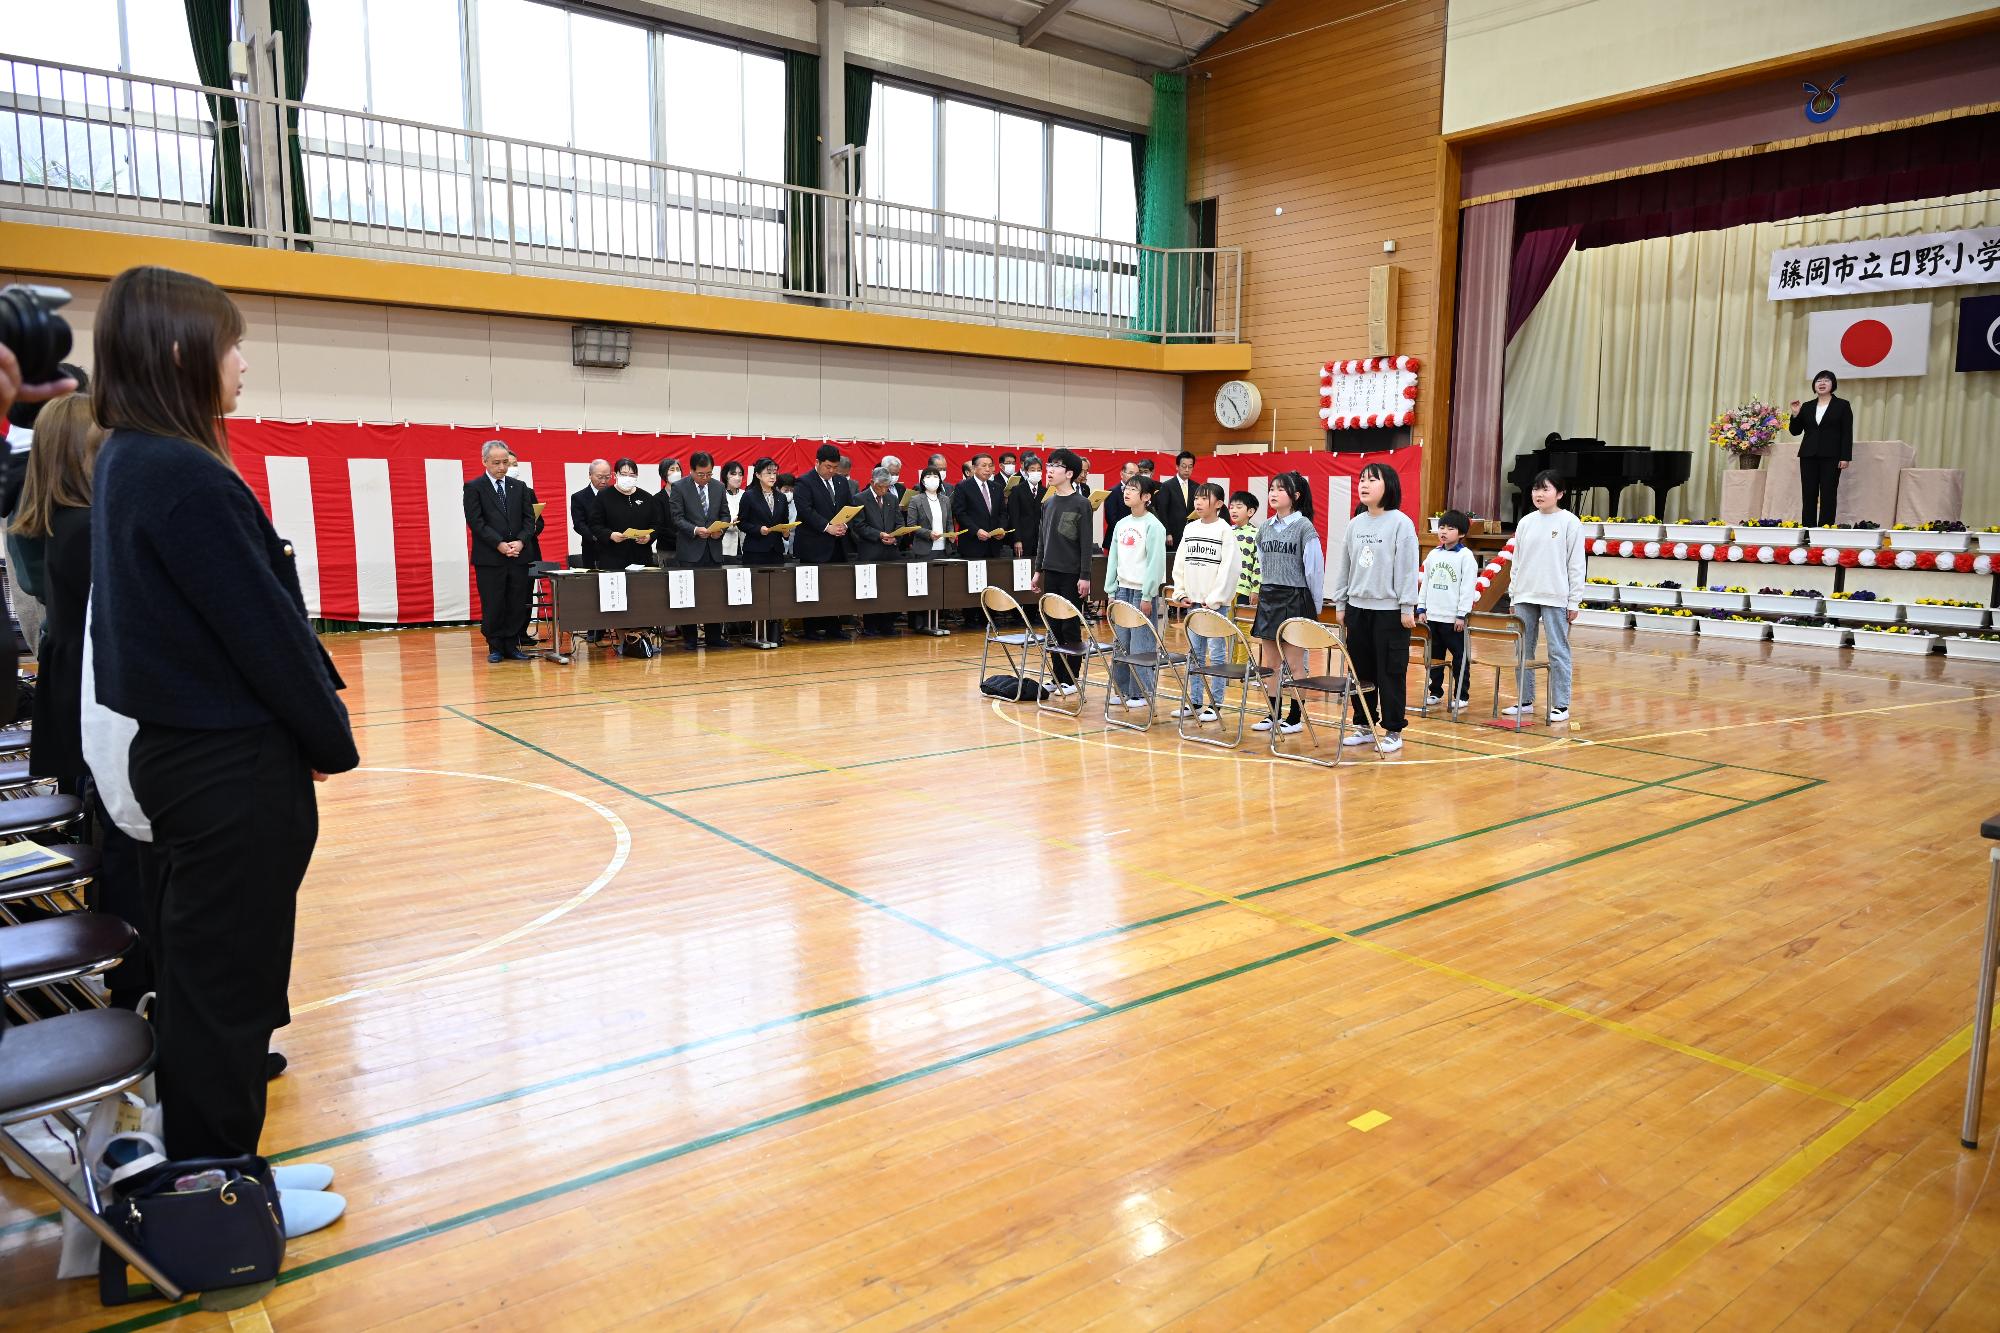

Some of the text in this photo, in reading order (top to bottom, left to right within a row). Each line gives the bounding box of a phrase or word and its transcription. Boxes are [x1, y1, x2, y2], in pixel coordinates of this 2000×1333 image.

[1778, 239, 2000, 290] 藤岡市立日野小学
[1186, 542, 1217, 556] uphoria
